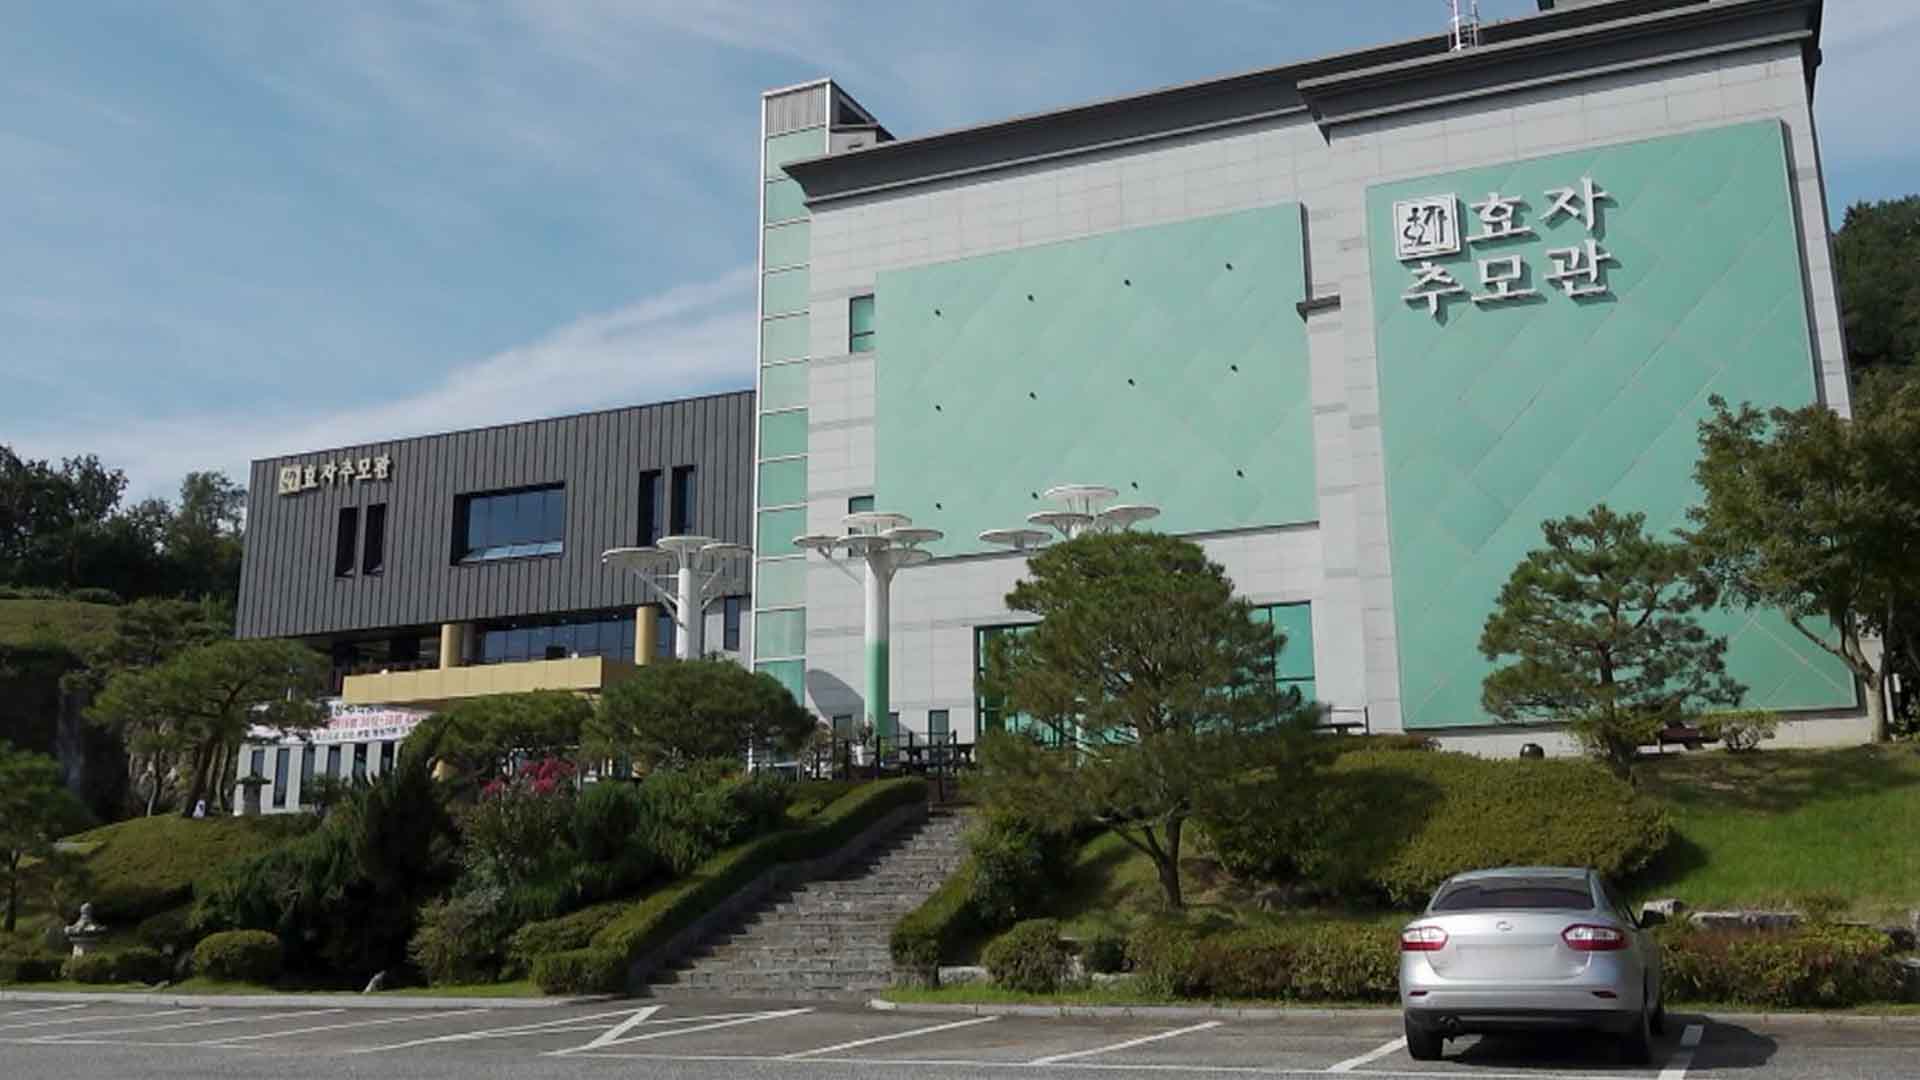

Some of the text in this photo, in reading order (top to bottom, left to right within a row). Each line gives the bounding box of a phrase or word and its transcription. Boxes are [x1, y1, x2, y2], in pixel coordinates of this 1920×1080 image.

[1465, 176, 1608, 242] 효자
[1401, 238, 1611, 318] 추모관
[301, 453, 391, 489] 효자추모관
